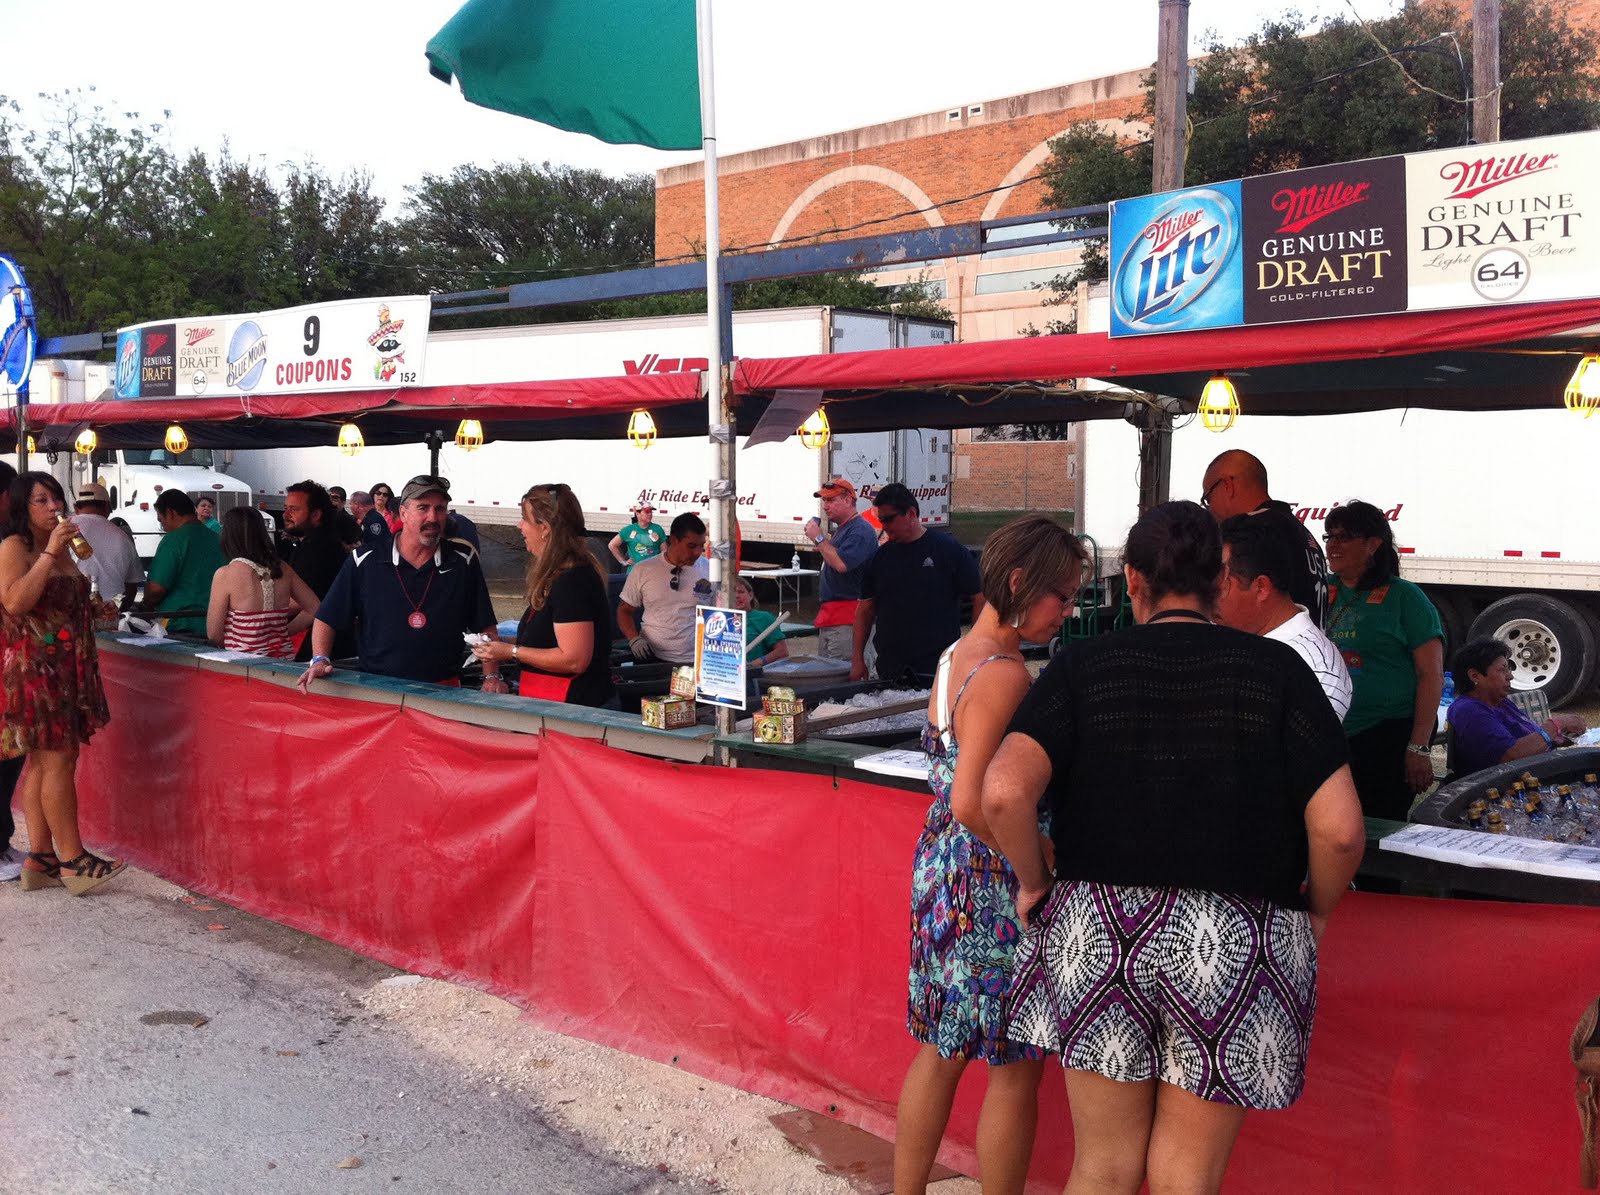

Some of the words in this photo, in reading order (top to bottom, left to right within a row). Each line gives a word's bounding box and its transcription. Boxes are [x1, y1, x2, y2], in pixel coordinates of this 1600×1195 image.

[1440, 153, 1558, 199] Miller
[1271, 181, 1371, 233] Miller
[1428, 193, 1574, 222] GENUINE
[1144, 208, 1203, 254] Miller
[1262, 227, 1384, 258] GENUINE
[1421, 213, 1582, 252] DRAFT
[1423, 253, 1472, 271] Light
[1528, 242, 1577, 258] Beer
[1132, 223, 1220, 322] Lite
[1256, 250, 1392, 291] DRAFT
[1477, 261, 1524, 282] 64
[1270, 286, 1375, 303] COLD-FILTERED
[184, 327, 215, 346] Miller
[303, 315, 320, 357] 9
[143, 355, 171, 367] GENUINE
[180, 355, 221, 369] DRAFT
[181, 346, 220, 356] GENUINE
[226, 358, 248, 387] BLUE
[248, 339, 267, 369] MOON
[142, 366, 173, 381] DRAFT
[193, 375, 206, 385] 64
[276, 357, 352, 386] COUPONS
[400, 372, 416, 383] 152
[637, 488, 657, 501] Air
[660, 488, 689, 503] Ride
[908, 484, 948, 501] uipped
[1332, 630, 1357, 639] 2011
